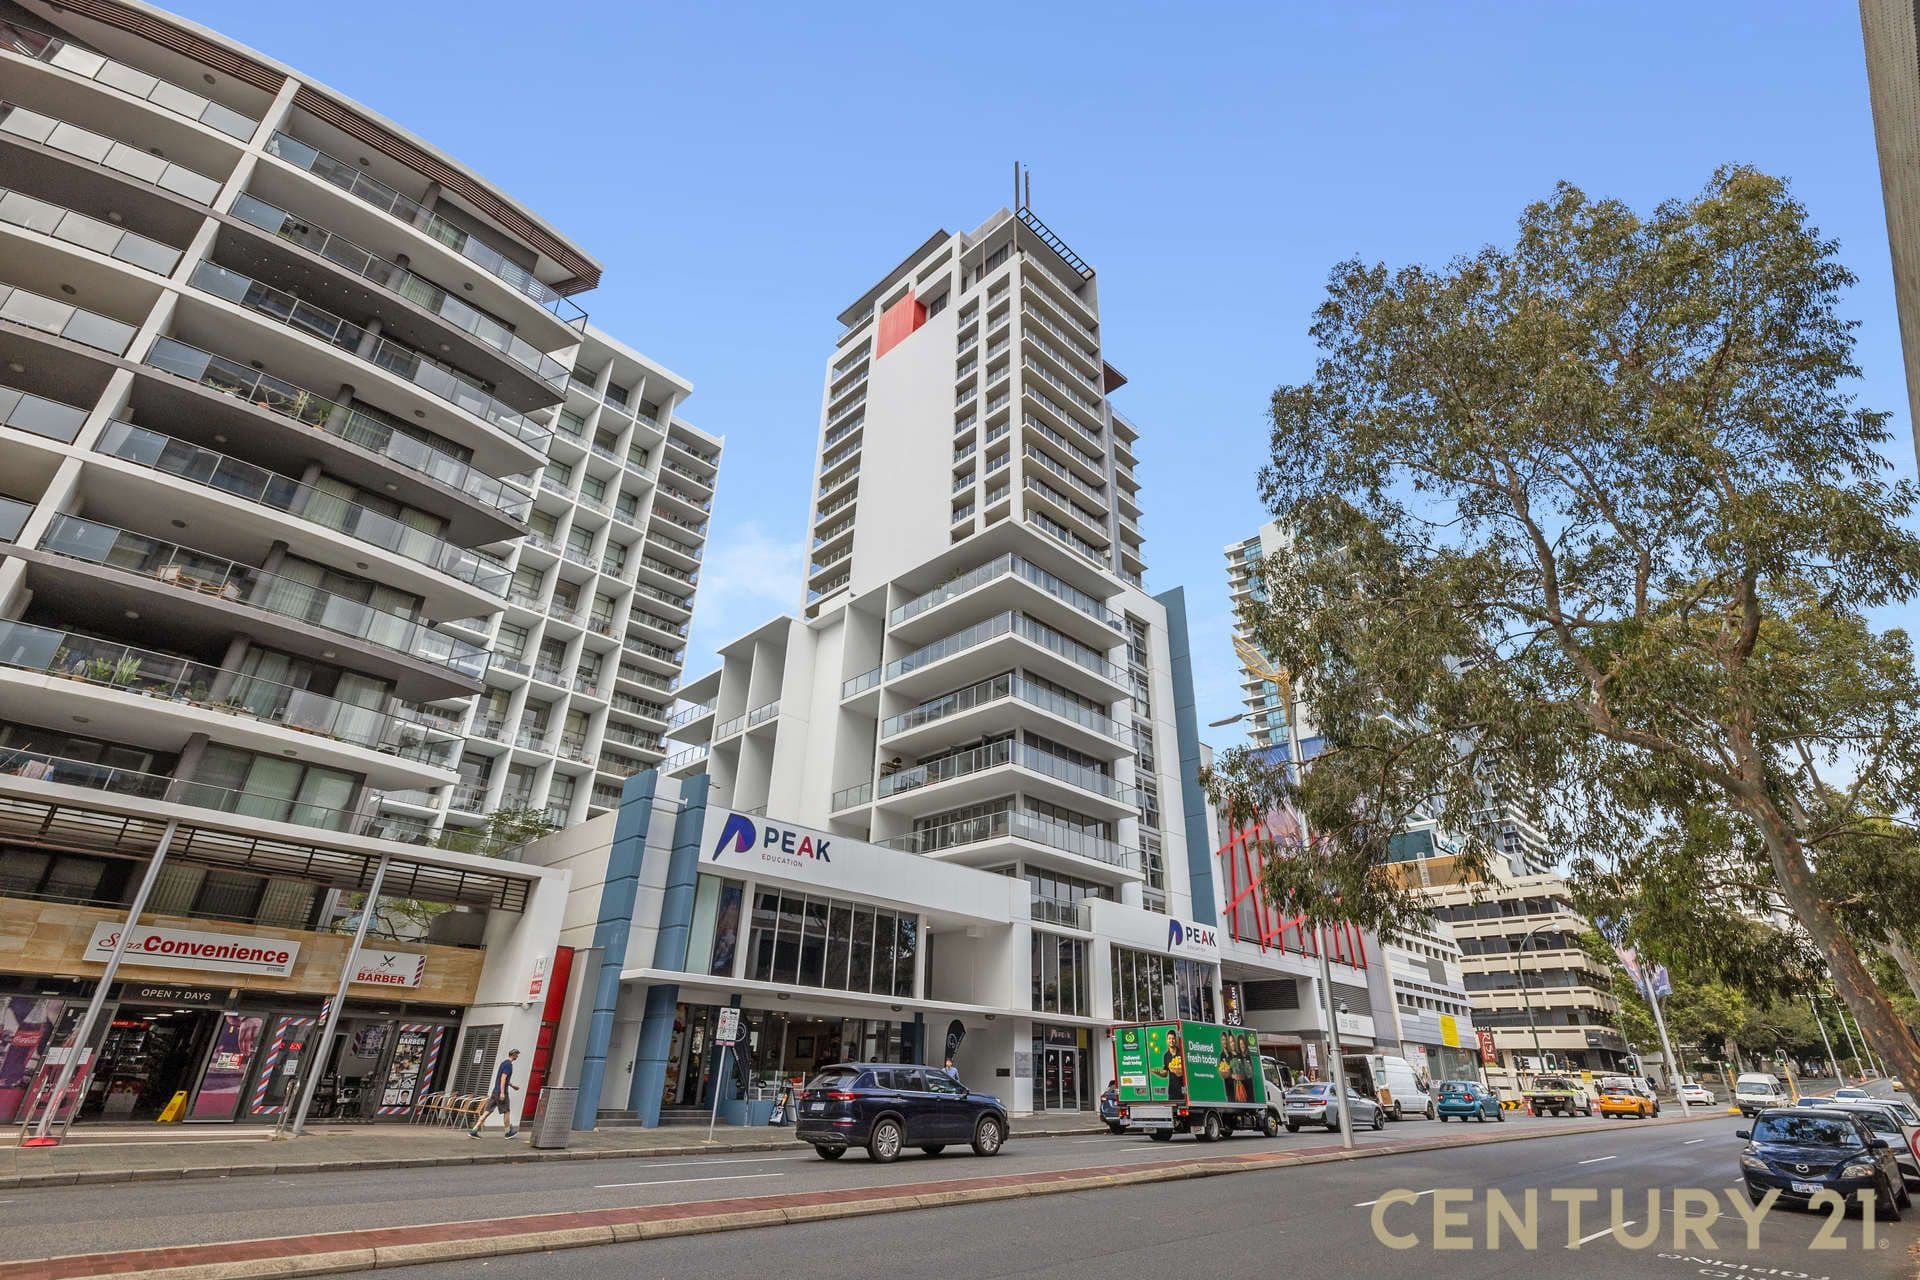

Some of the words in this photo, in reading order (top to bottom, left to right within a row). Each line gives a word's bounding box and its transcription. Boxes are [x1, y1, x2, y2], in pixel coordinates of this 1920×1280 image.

[763, 826, 831, 863] PEAK
[761, 853, 803, 868] EDUCATION
[1185, 926, 1217, 948] PEAK
[143, 935, 289, 964] Convenience
[356, 972, 406, 985] BARBER
[141, 988, 171, 998] OPEN
[174, 990, 182, 999] 7
[184, 990, 212, 1001] DAYS
[399, 1038, 426, 1046] BARBER
[1188, 1040, 1214, 1053] Delivered
[1187, 1052, 1202, 1064] fresh
[1202, 1055, 1218, 1068] today
